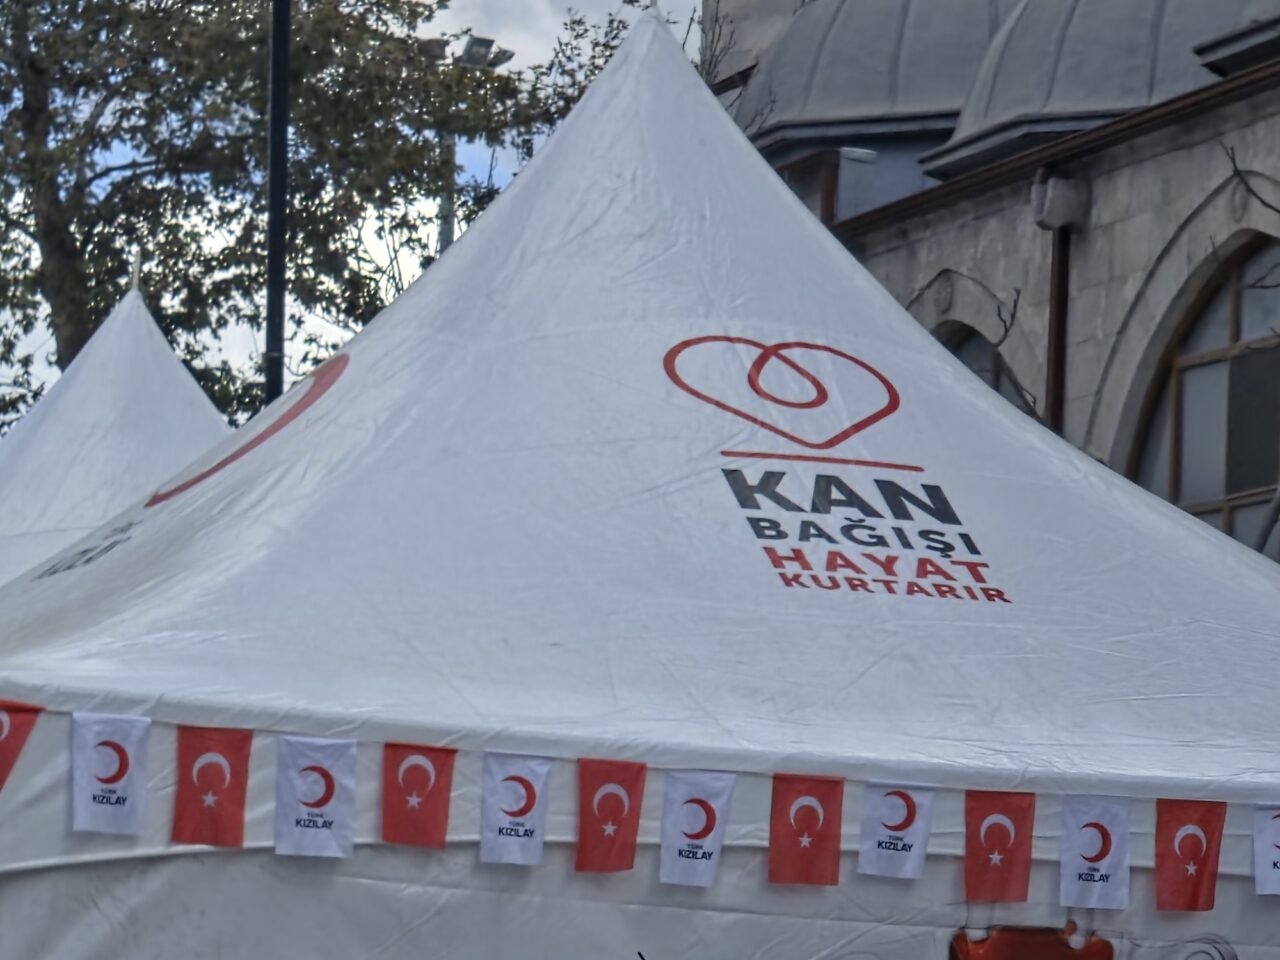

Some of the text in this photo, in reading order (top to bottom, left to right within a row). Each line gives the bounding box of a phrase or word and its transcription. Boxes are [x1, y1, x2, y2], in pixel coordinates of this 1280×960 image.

[721, 468, 963, 526] KAN
[746, 516, 982, 559] BAĞIŞI
[762, 546, 990, 584] HAYAT
[778, 572, 1012, 603] KURTARIR
[877, 840, 913, 852] KIZILAY
